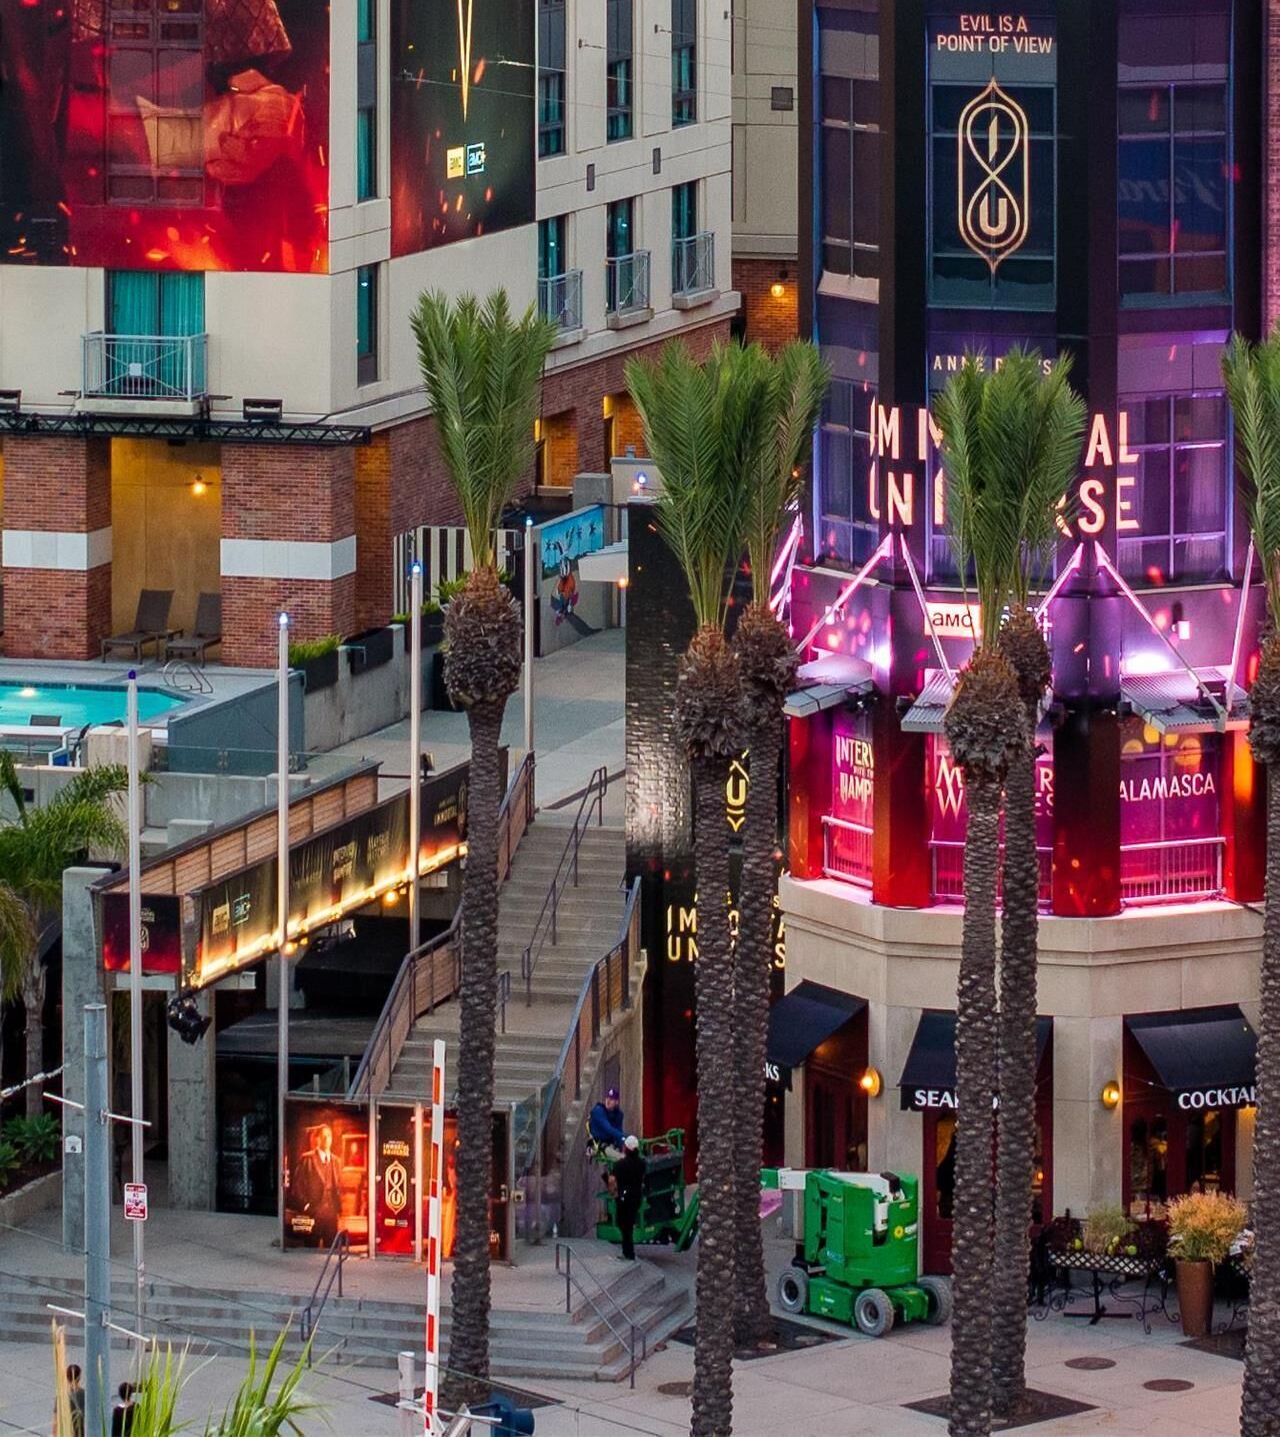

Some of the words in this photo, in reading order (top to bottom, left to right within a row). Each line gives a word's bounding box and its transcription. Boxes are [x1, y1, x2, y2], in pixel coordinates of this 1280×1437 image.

[960, 14, 995, 33] EVIL
[999, 15, 1013, 33] IS
[1016, 15, 1028, 33] A
[937, 34, 986, 52] POINT
[988, 34, 1009, 52] OF
[1013, 36, 1053, 54] VIEW
